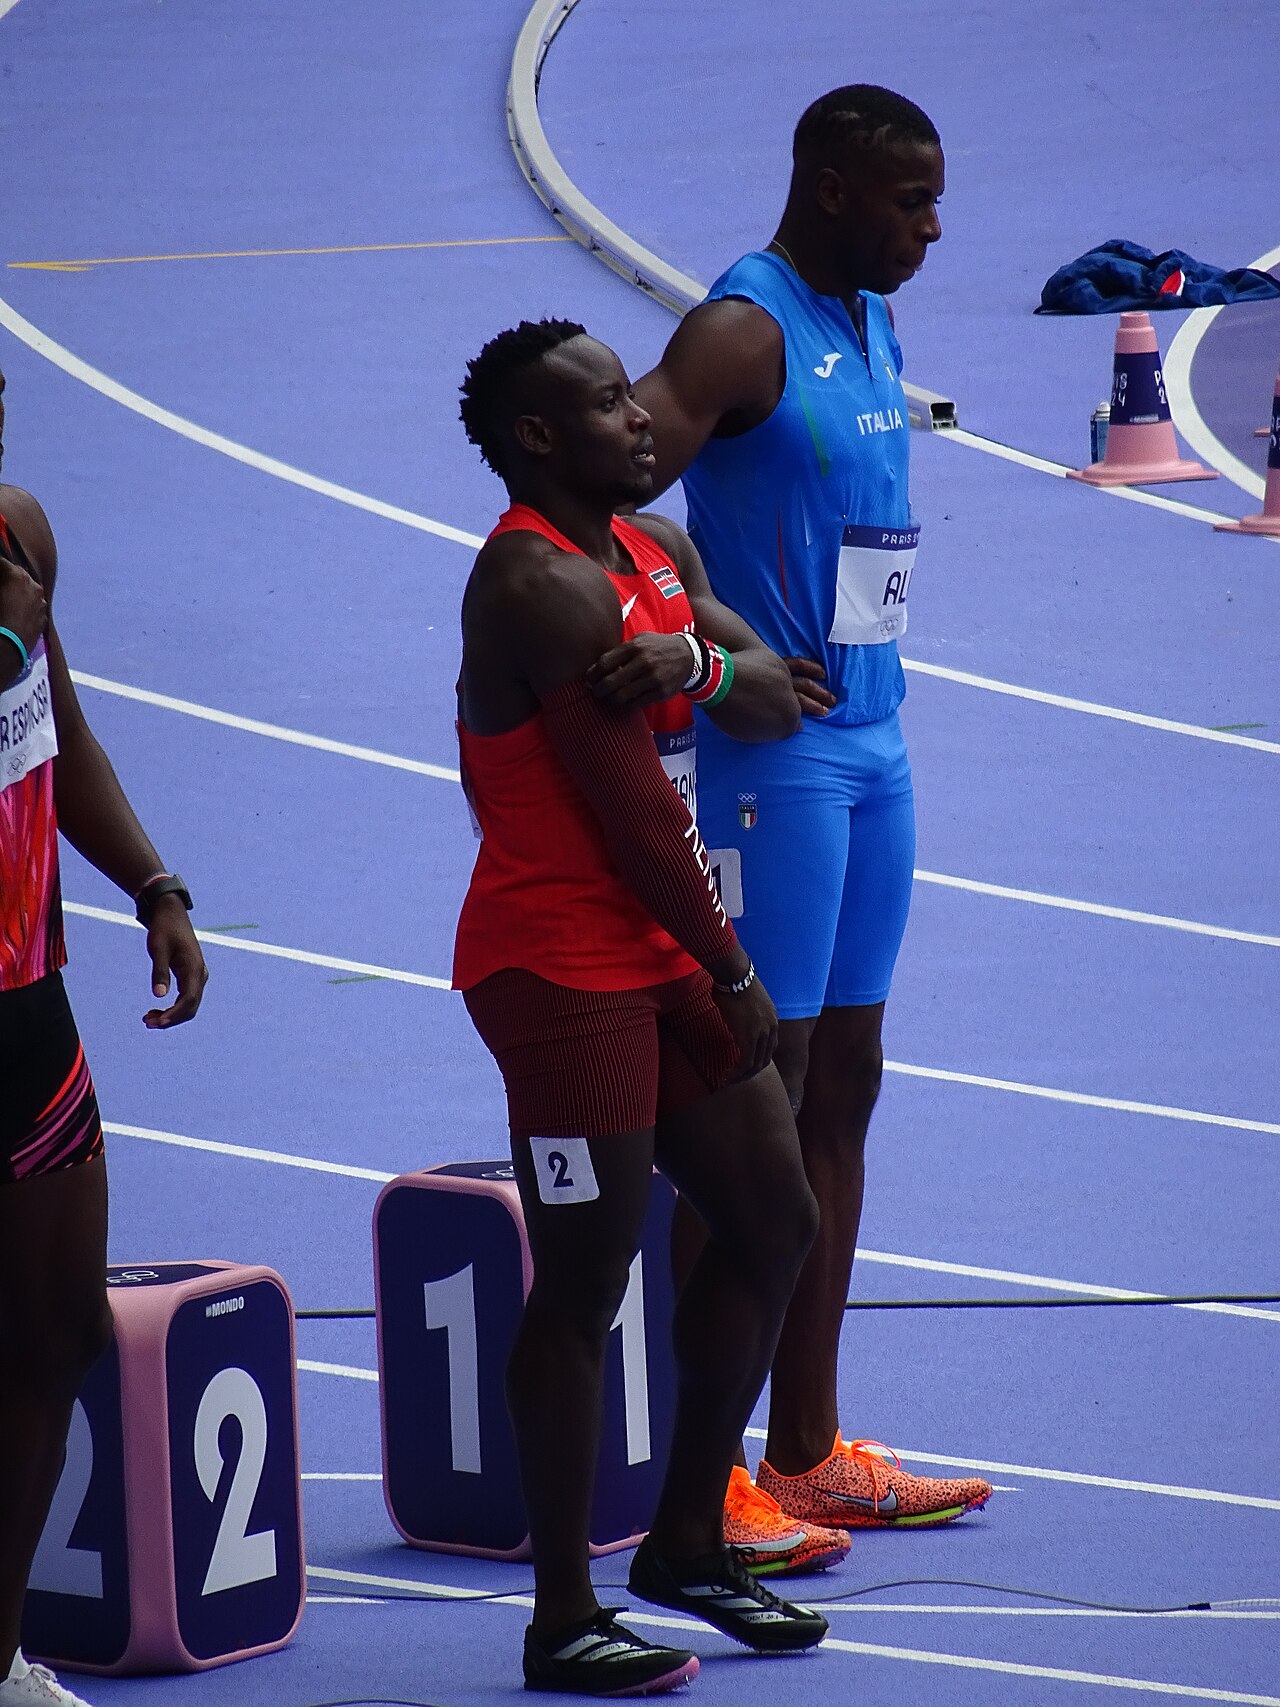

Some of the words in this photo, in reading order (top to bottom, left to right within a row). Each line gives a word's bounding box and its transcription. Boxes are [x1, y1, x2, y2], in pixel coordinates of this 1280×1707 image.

[857, 408, 904, 436] ITALIA
[882, 533, 912, 544] PARIS
[882, 568, 914, 606] AL
[548, 1151, 574, 1188] 2
[424, 1262, 482, 1474] 1
[609, 1249, 651, 1466] 1
[194, 1367, 277, 1597] 2
